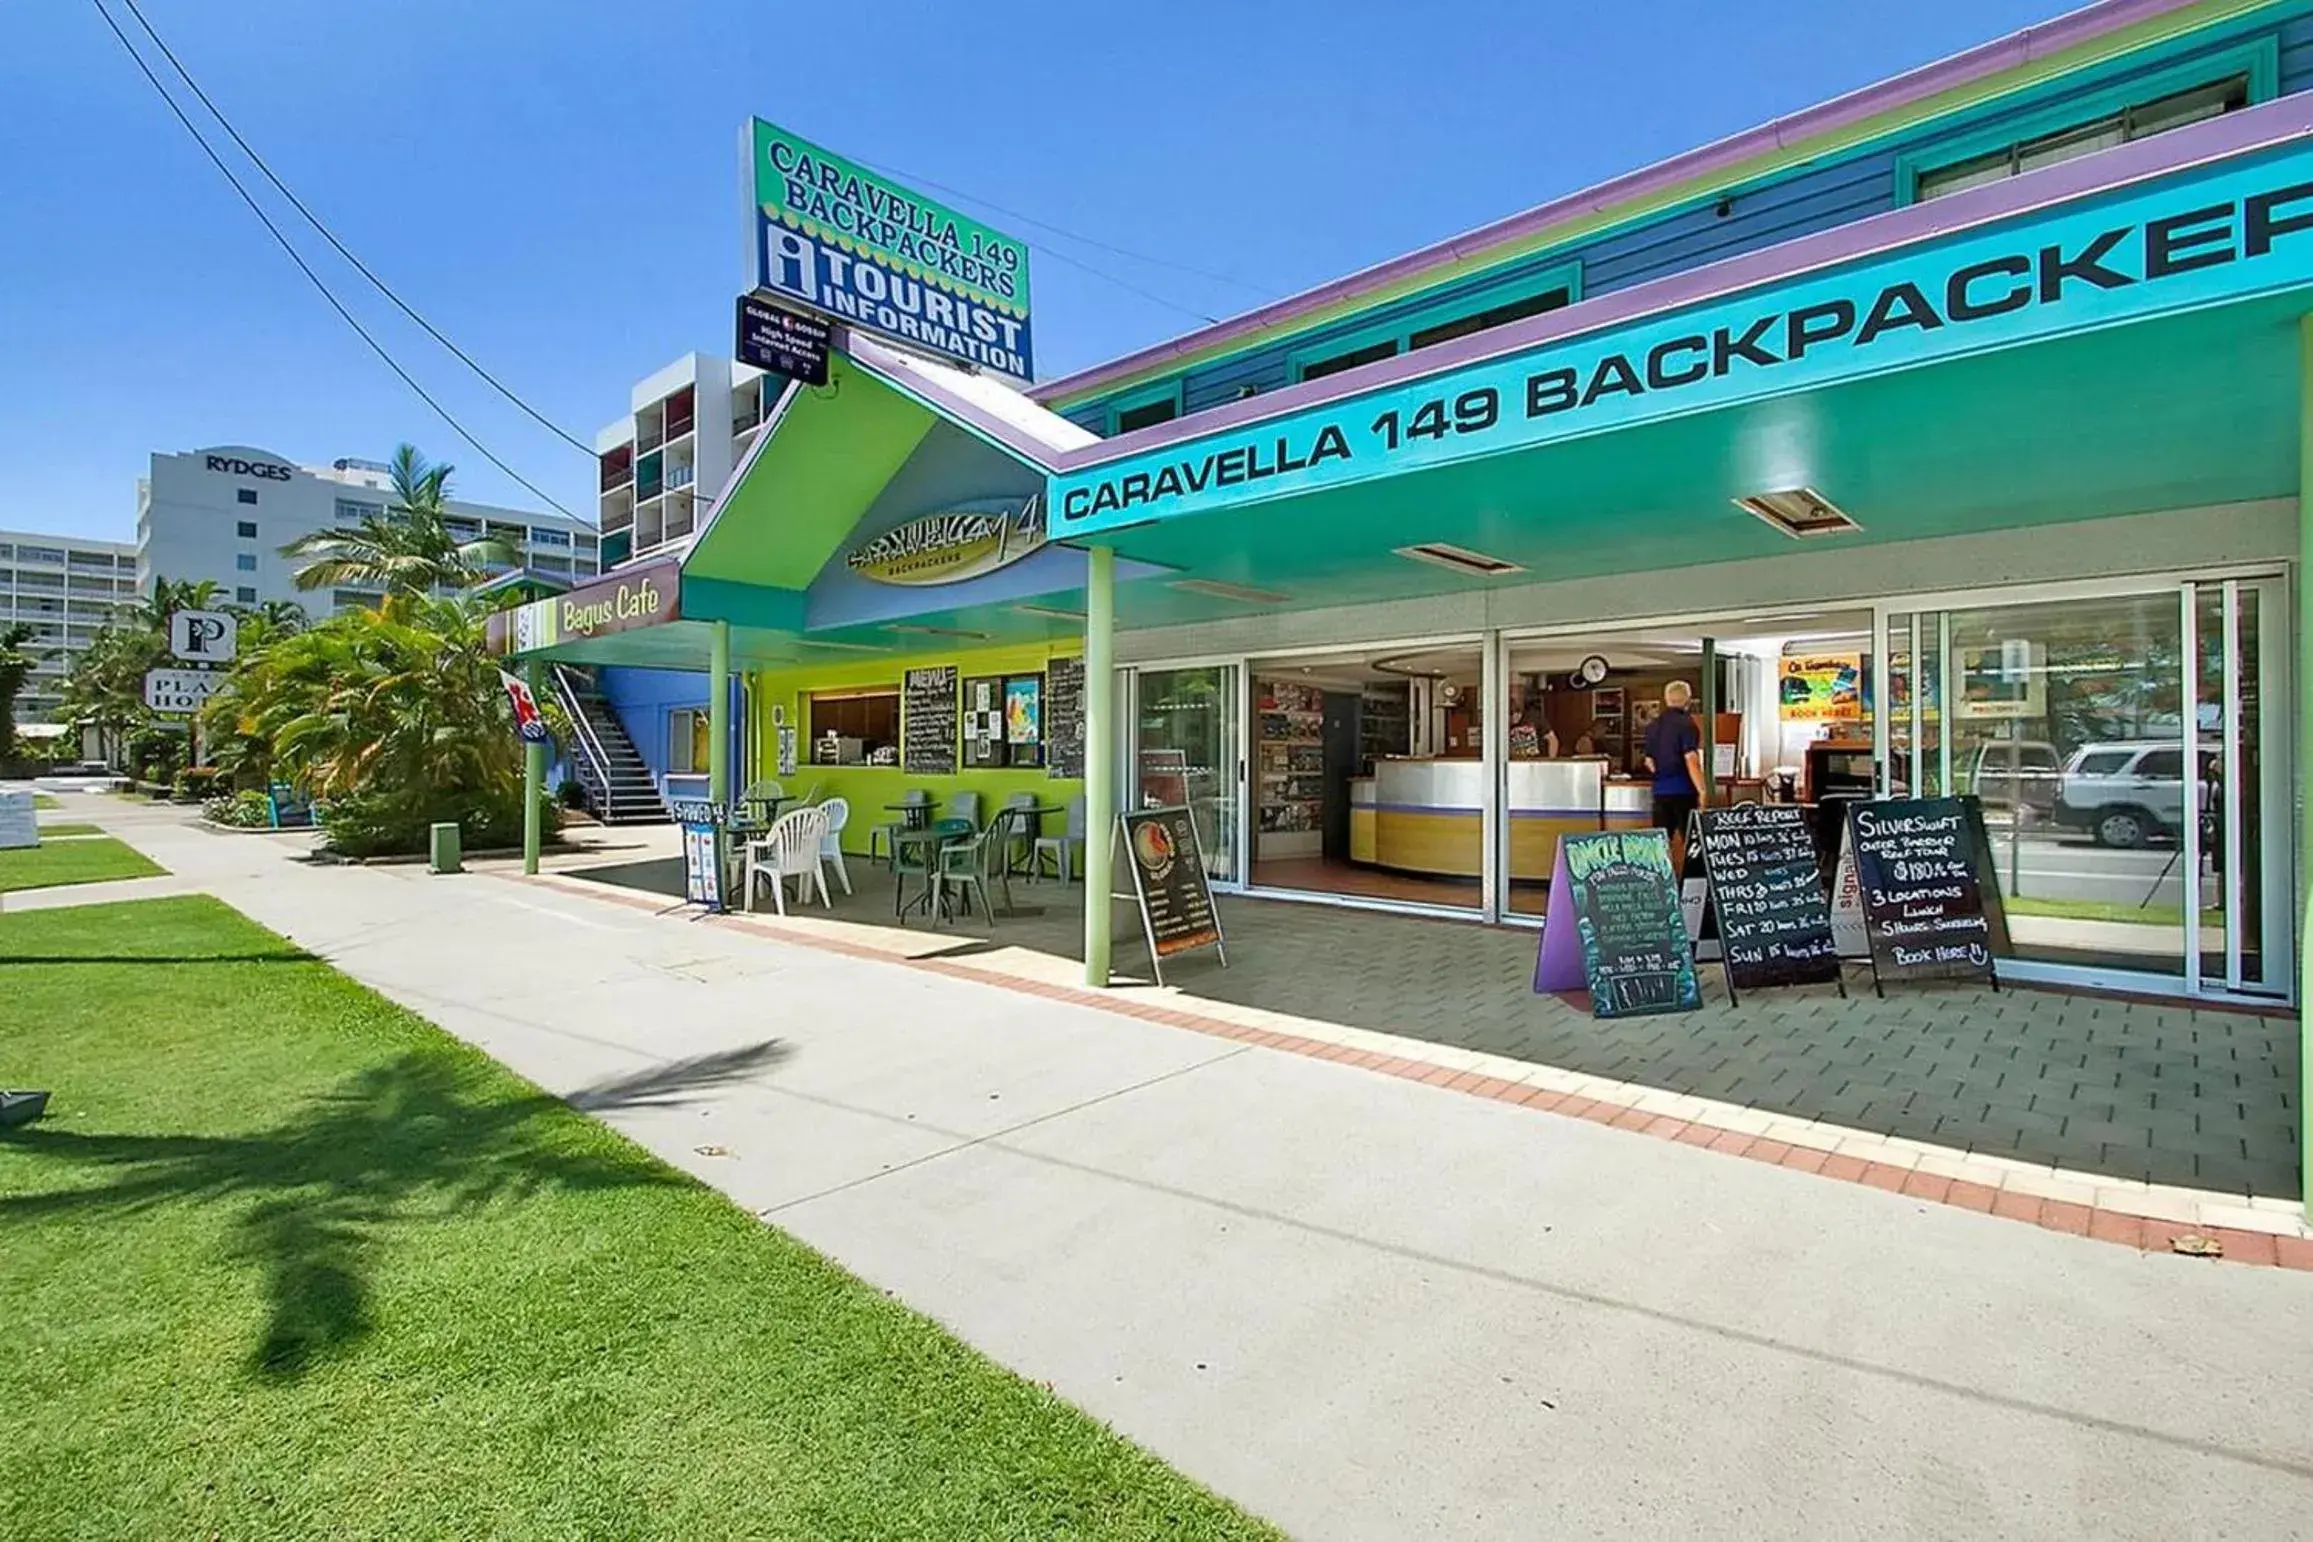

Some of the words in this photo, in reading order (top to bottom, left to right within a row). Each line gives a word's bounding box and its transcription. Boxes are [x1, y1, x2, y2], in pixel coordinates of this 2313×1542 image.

[769, 140, 960, 251] CARAVELLA
[971, 234, 1019, 275] 149
[784, 176, 1014, 299] BACKPACKERS
[820, 245, 1023, 352] TOURIST
[822, 288, 1025, 377] INFORMATION
[1064, 424, 1351, 522] CARAVELLA
[1371, 386, 1499, 451] 149
[206, 454, 291, 482] RYDGES
[888, 522, 962, 576] BACKPACKERS
[563, 600, 613, 636] Bagus
[617, 578, 659, 619] Cafe
[1706, 832, 1741, 850] MON
[1708, 851, 1745, 868] TUES
[1914, 847, 1950, 858] TOUR
[1712, 869, 1749, 882] WED
[1871, 889, 1886, 907] 3
[1887, 886, 1963, 903] LOCATIONS
[1722, 901, 1753, 917] FRI
[1903, 903, 1944, 918] LUNCH
[1725, 920, 1756, 939] SAT
[1881, 920, 1894, 937] 5
[1729, 946, 1764, 964] SUN
[1892, 946, 1932, 966] BOOK
